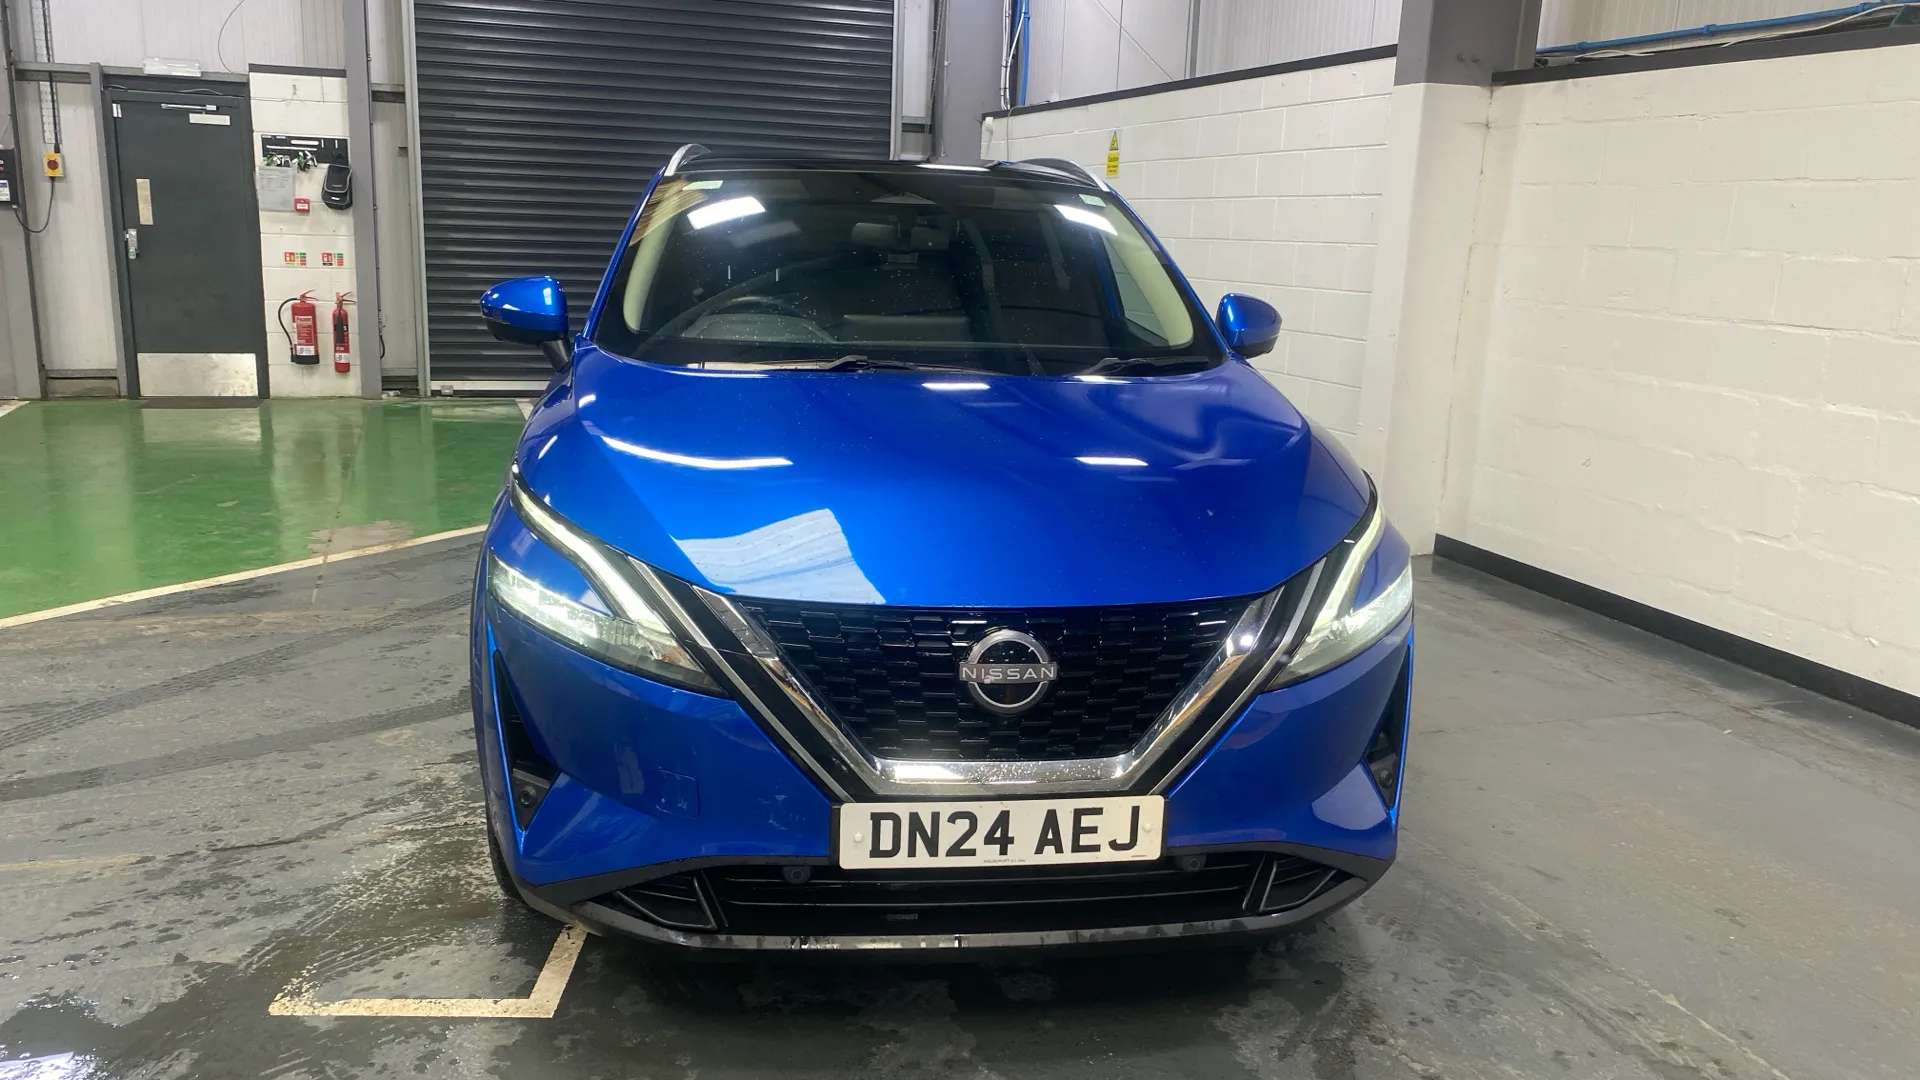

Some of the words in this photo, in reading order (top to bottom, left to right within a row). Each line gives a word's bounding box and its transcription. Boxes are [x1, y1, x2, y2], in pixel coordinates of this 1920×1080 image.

[962, 666, 1054, 680] NISSAN
[869, 809, 1015, 858] DN24
[1034, 805, 1141, 855] AEJ
